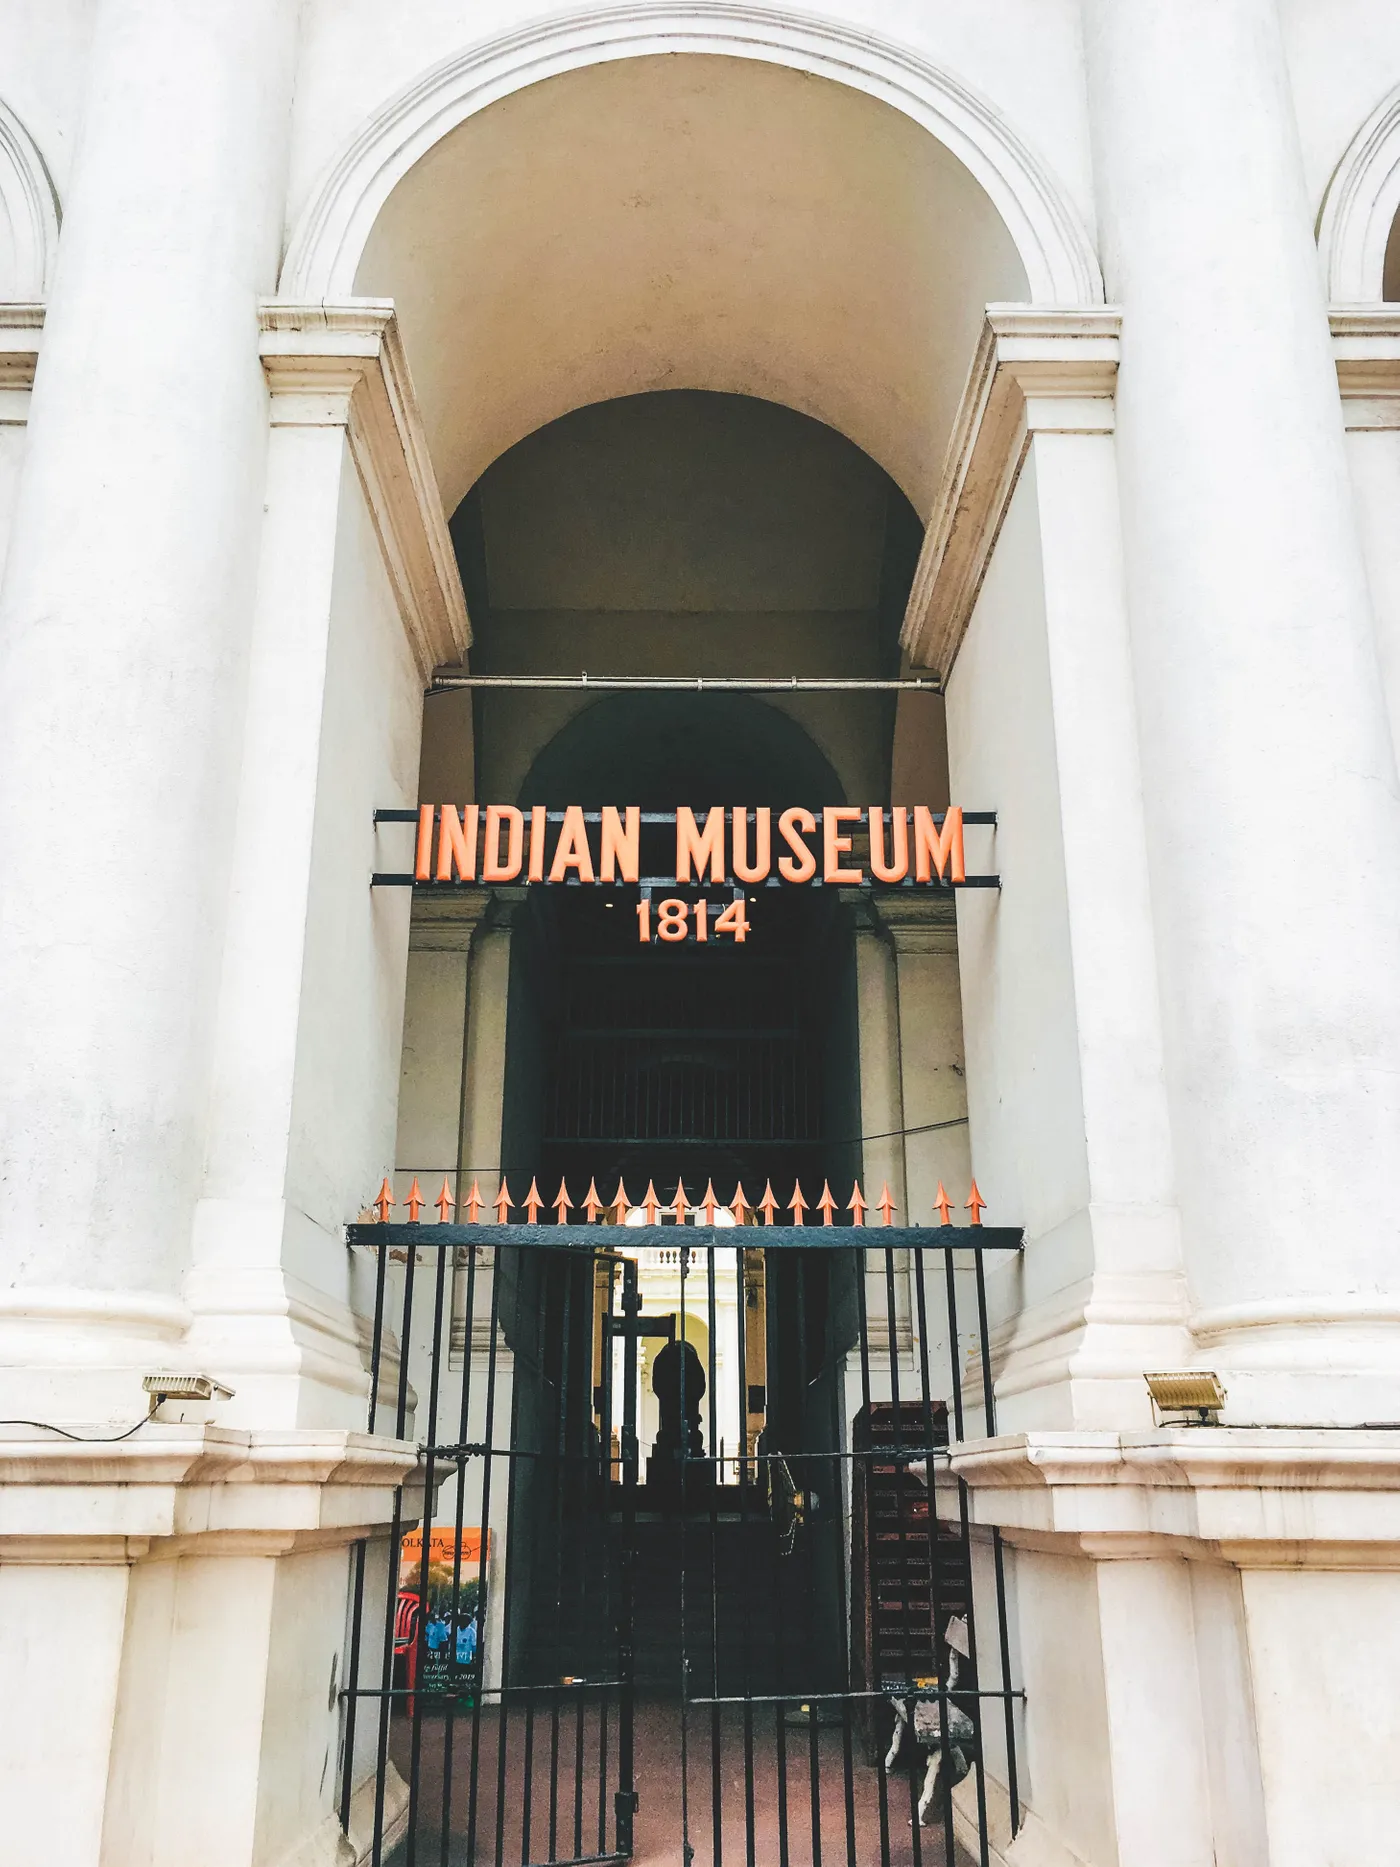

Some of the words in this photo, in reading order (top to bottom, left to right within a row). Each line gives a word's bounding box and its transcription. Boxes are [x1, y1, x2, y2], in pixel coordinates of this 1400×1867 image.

[414, 803, 641, 883] INDIAN
[675, 805, 966, 884] MUSEUM
[636, 898, 751, 943] 1814
[402, 1537, 445, 1548] OLKTA
